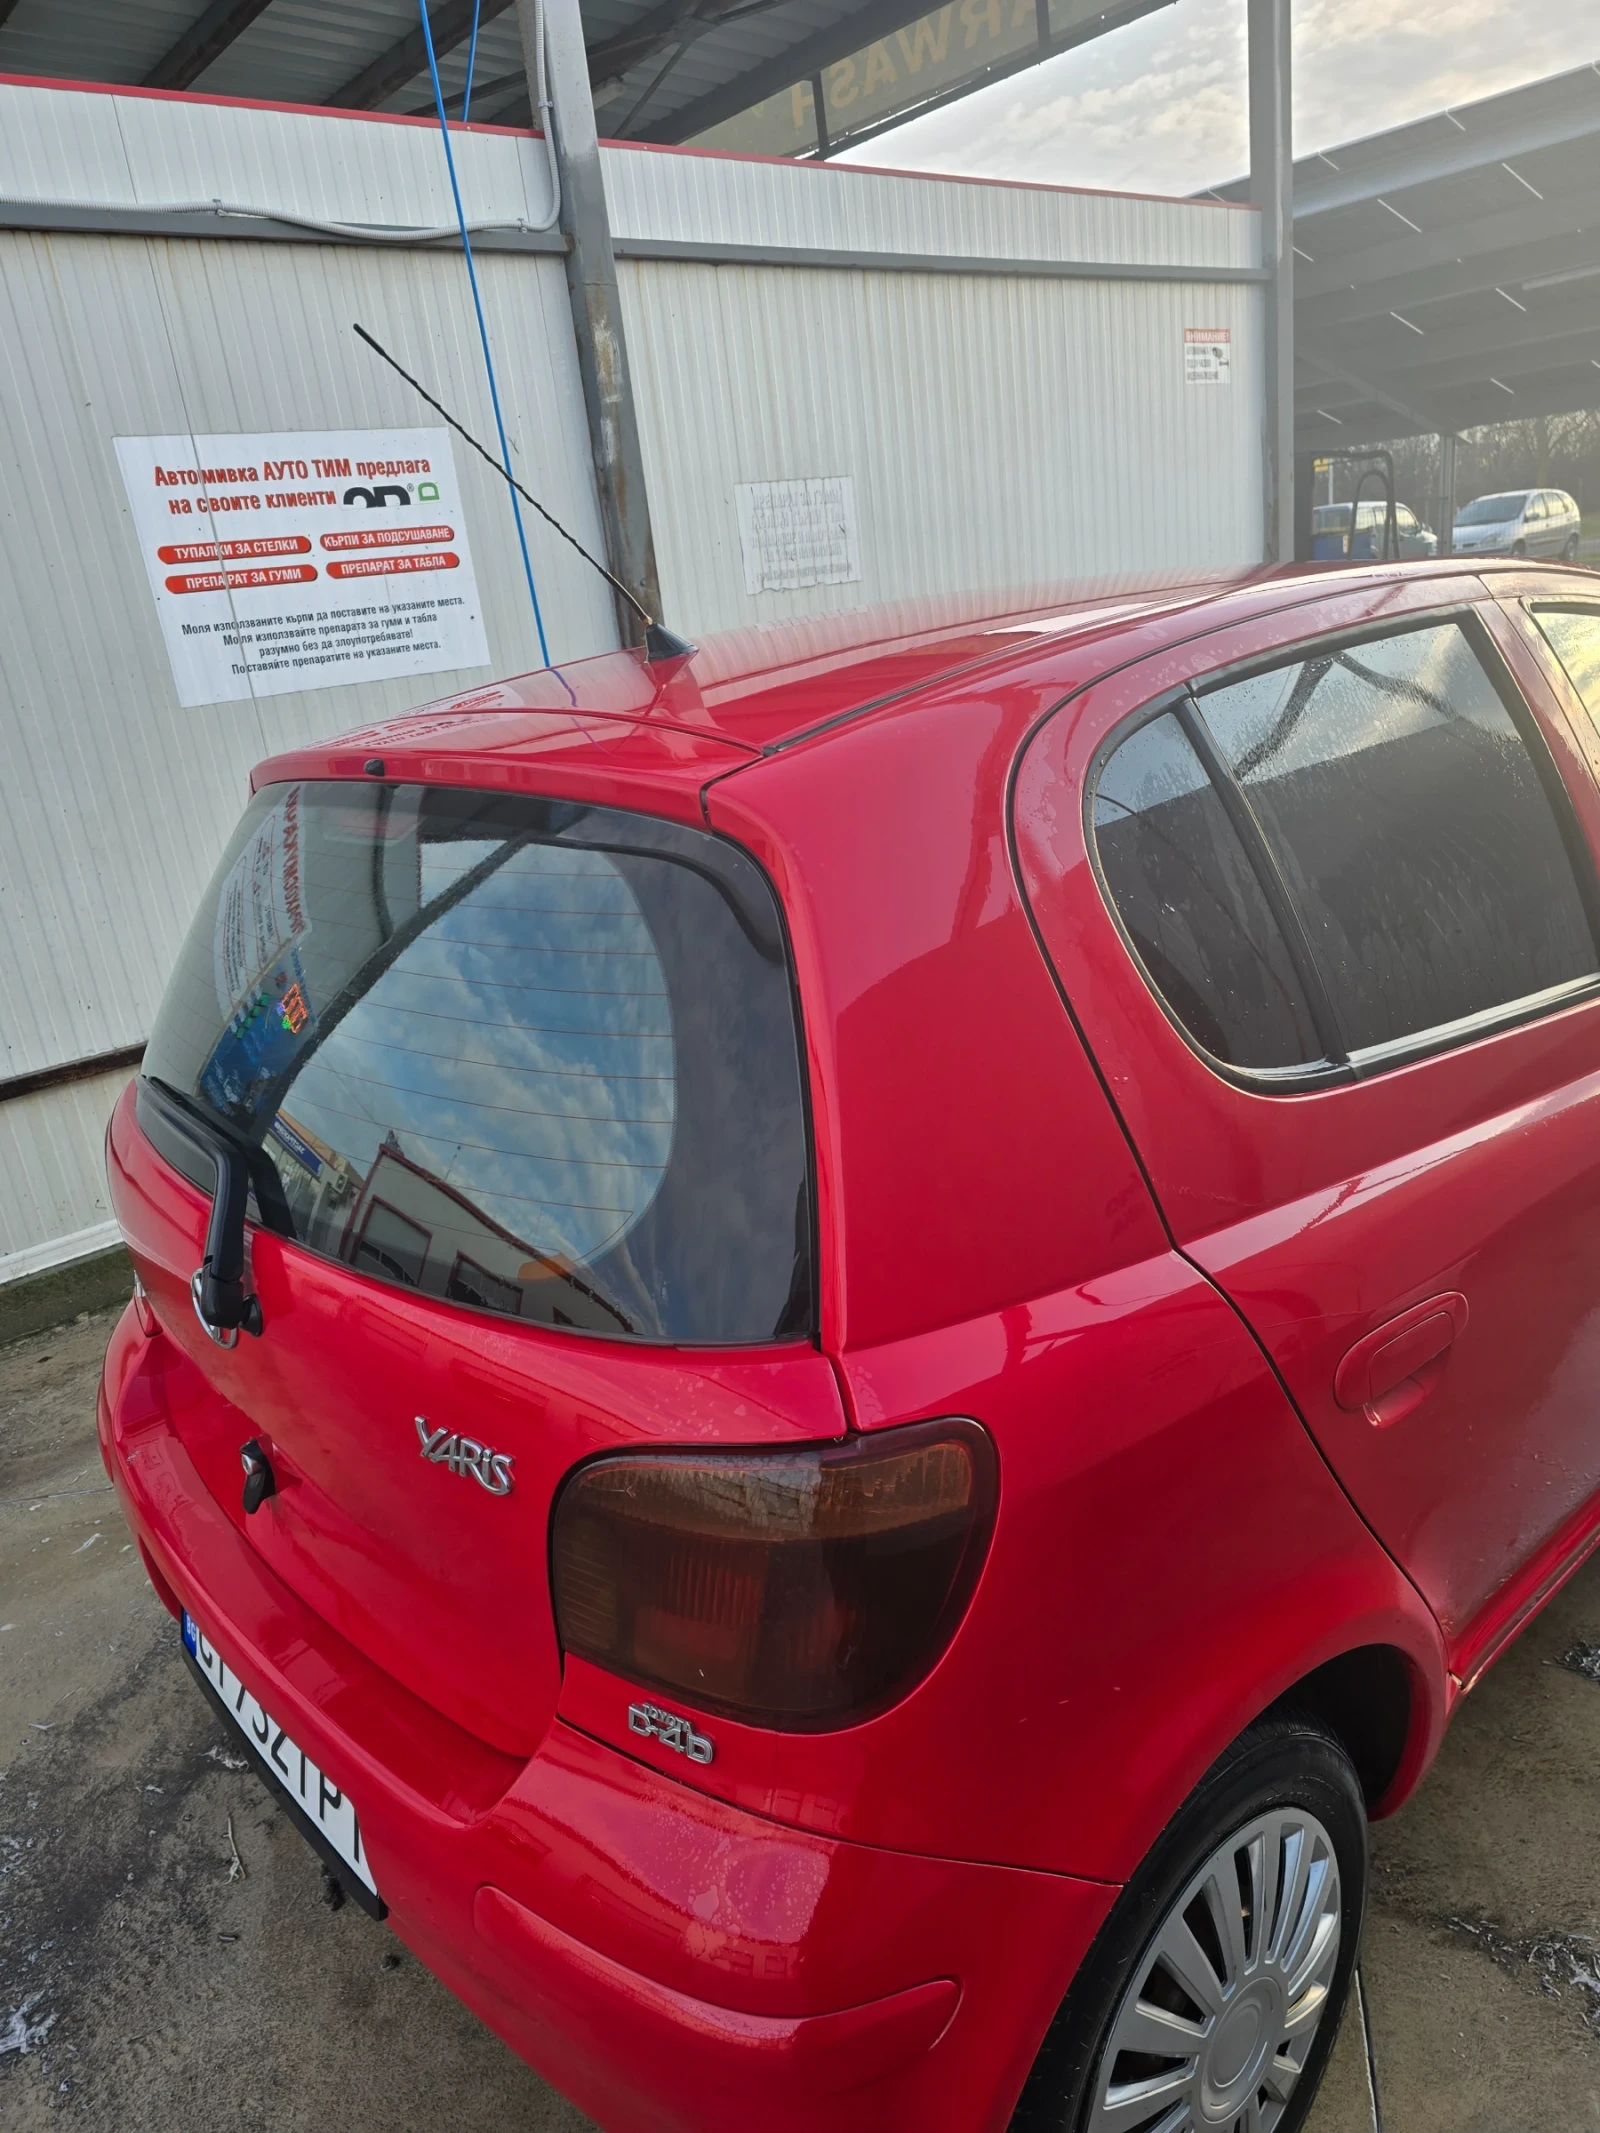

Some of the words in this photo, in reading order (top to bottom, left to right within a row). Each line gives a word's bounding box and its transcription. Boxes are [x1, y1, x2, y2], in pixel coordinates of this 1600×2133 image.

[155, 465, 259, 487] Автомивка
[263, 460, 309, 481] АУТО
[311, 458, 352, 478] ТИМ
[356, 459, 431, 480] предлага
[168, 499, 192, 514] на
[197, 494, 261, 513] своите
[265, 491, 337, 508] клиенти
[174, 544, 233, 559] ТУПАЛКИ
[235, 543, 251, 555] ЗА
[253, 539, 298, 553] СТЕЛКИ
[324, 535, 359, 547] КЪРПИ
[362, 533, 375, 544] ЗА
[377, 527, 450, 543] ПОДСУШАВАНЕ
[186, 573, 248, 589] ПРЕПАРАТ
[251, 571, 268, 583] ЗА
[269, 568, 302, 581] ГУМИ
[340, 560, 396, 575] ПРЕПАРАТ
[398, 558, 412, 569] ЗА
[413, 555, 446, 568] ТАБЛА
[181, 623, 211, 635] Моля
[214, 615, 283, 632] използваните
[286, 612, 314, 625] кърпи
[316, 611, 328, 622] да
[330, 606, 376, 619] поставите
[379, 604, 390, 614] на
[391, 599, 435, 614] указаните
[437, 597, 465, 607] места.
[223, 634, 253, 646] Моля
[255, 626, 316, 642] използвайте
[318, 622, 366, 636] препарата
[368, 620, 379, 629] за
[381, 617, 403, 630] гуми
[405, 617, 411, 625] и
[413, 612, 437, 623] табла
[231, 658, 290, 675] Поставяйте
[292, 652, 351, 668] препаратите
[353, 650, 364, 660] на
[366, 644, 411, 660] указаните
[413, 641, 441, 652] места.
[259, 642, 300, 659] разумно
[302, 641, 319, 652] без
[321, 639, 333, 651] да
[335, 628, 414, 648] злоупотребявате!
[186, 1614, 196, 1642] BG
[642, 1702, 692, 1735] TOYOTA
[628, 1705, 713, 1764] D-4D
